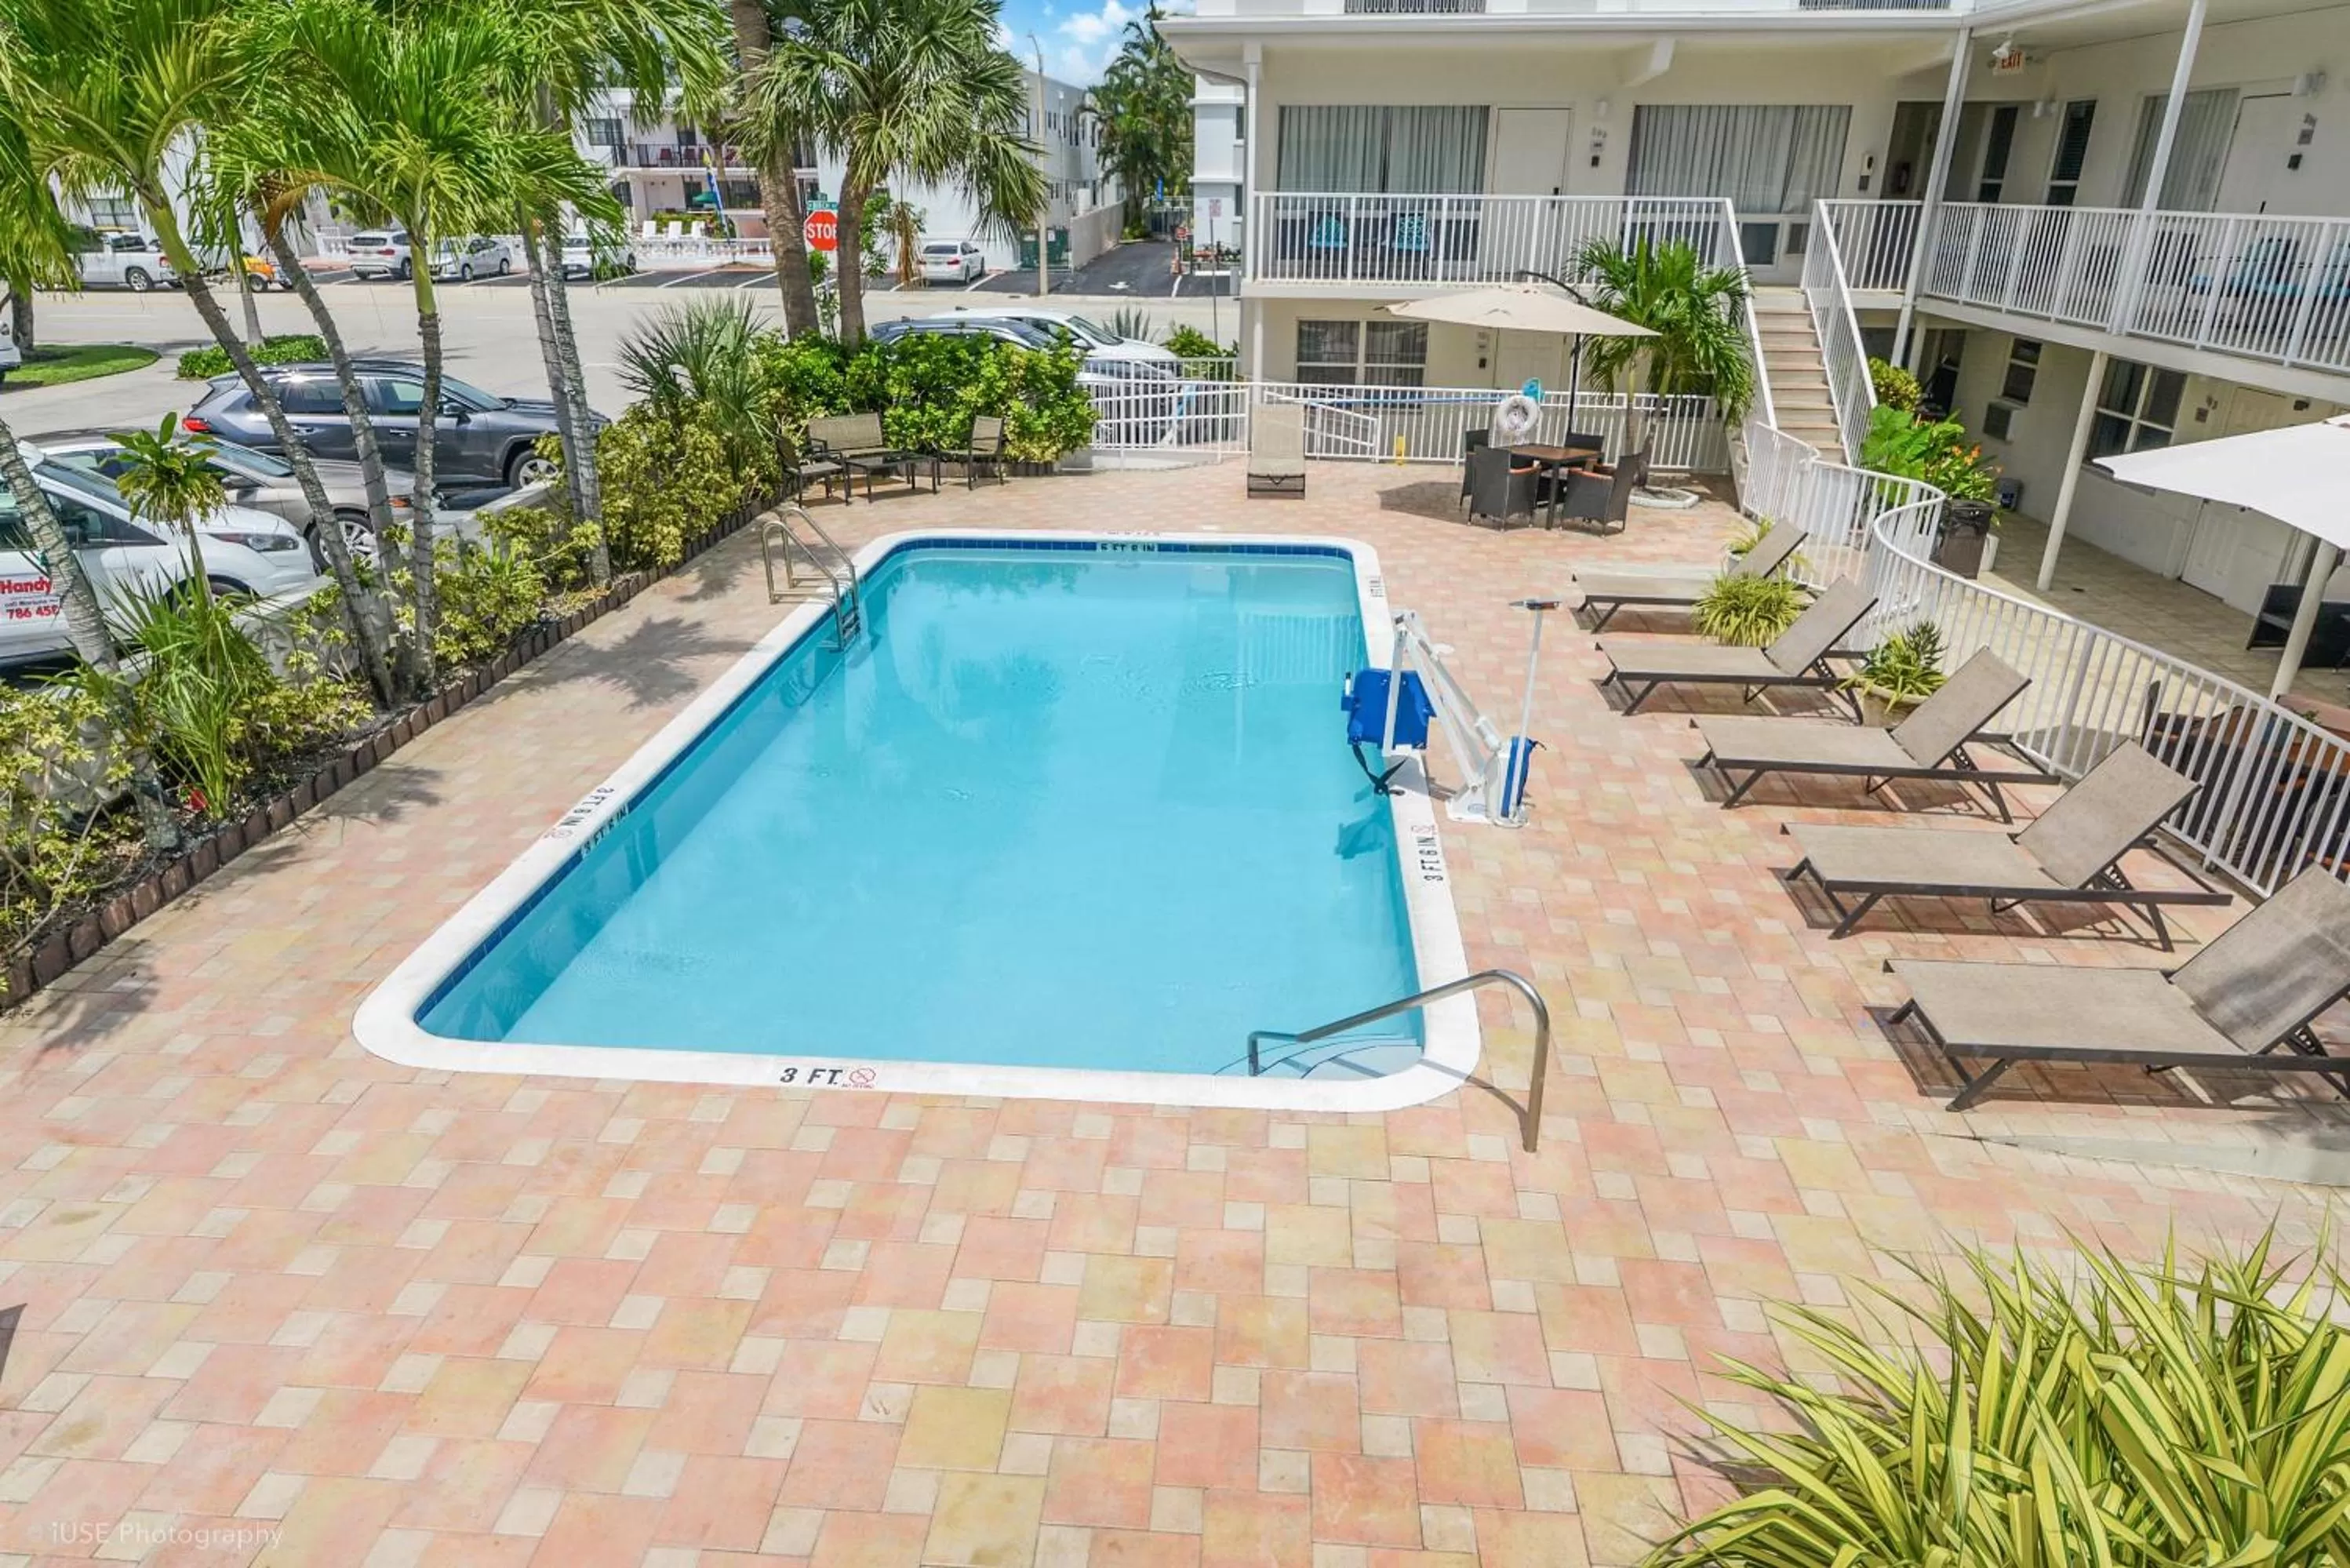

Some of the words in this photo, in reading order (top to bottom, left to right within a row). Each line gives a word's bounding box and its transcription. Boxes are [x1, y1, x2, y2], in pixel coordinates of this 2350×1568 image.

[2001, 52, 2022, 69] EXIT
[6, 607, 31, 619] 786
[1421, 859, 1442, 871] FT
[780, 1068, 798, 1083] 3
